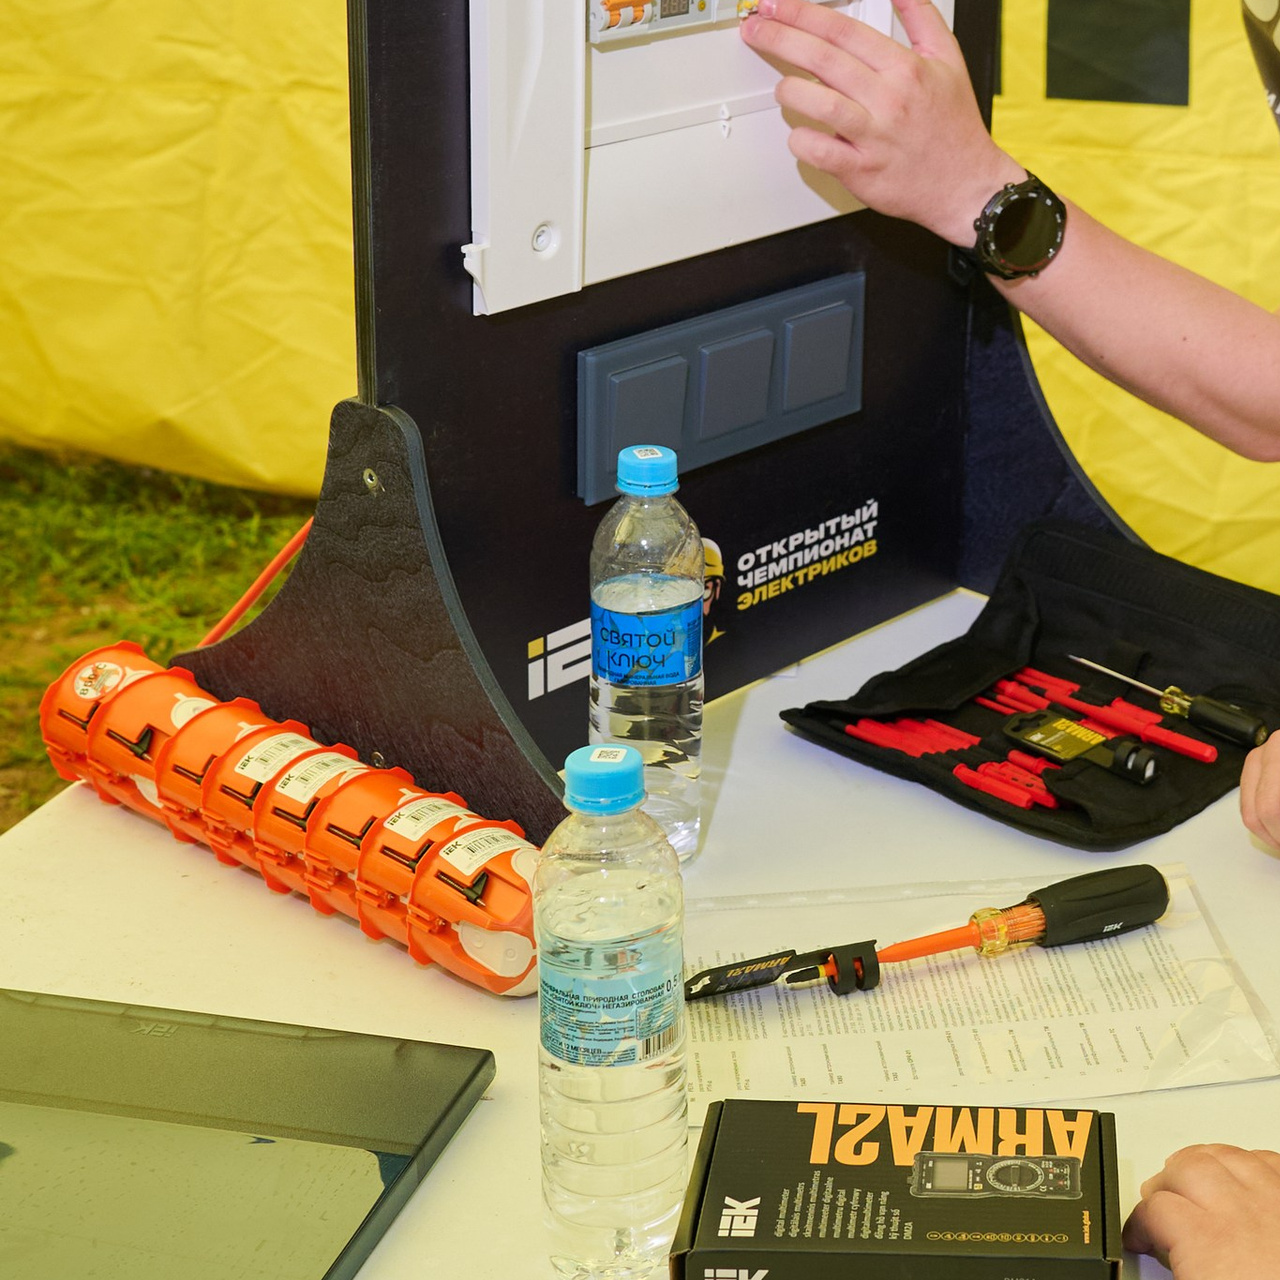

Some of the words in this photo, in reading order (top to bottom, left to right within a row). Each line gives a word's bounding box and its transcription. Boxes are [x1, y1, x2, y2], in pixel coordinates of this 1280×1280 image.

[737, 498, 879, 572] ОТКРЫТЫЙ
[737, 520, 878, 588] ЧЕМПИОНАТ
[737, 539, 878, 611] ЭЛЕКТРИКОВ
[600, 627, 676, 648] СВЯТОЙ
[607, 650, 665, 669] КЛЮЧ
[796, 1102, 1094, 1169] ARMA2L
